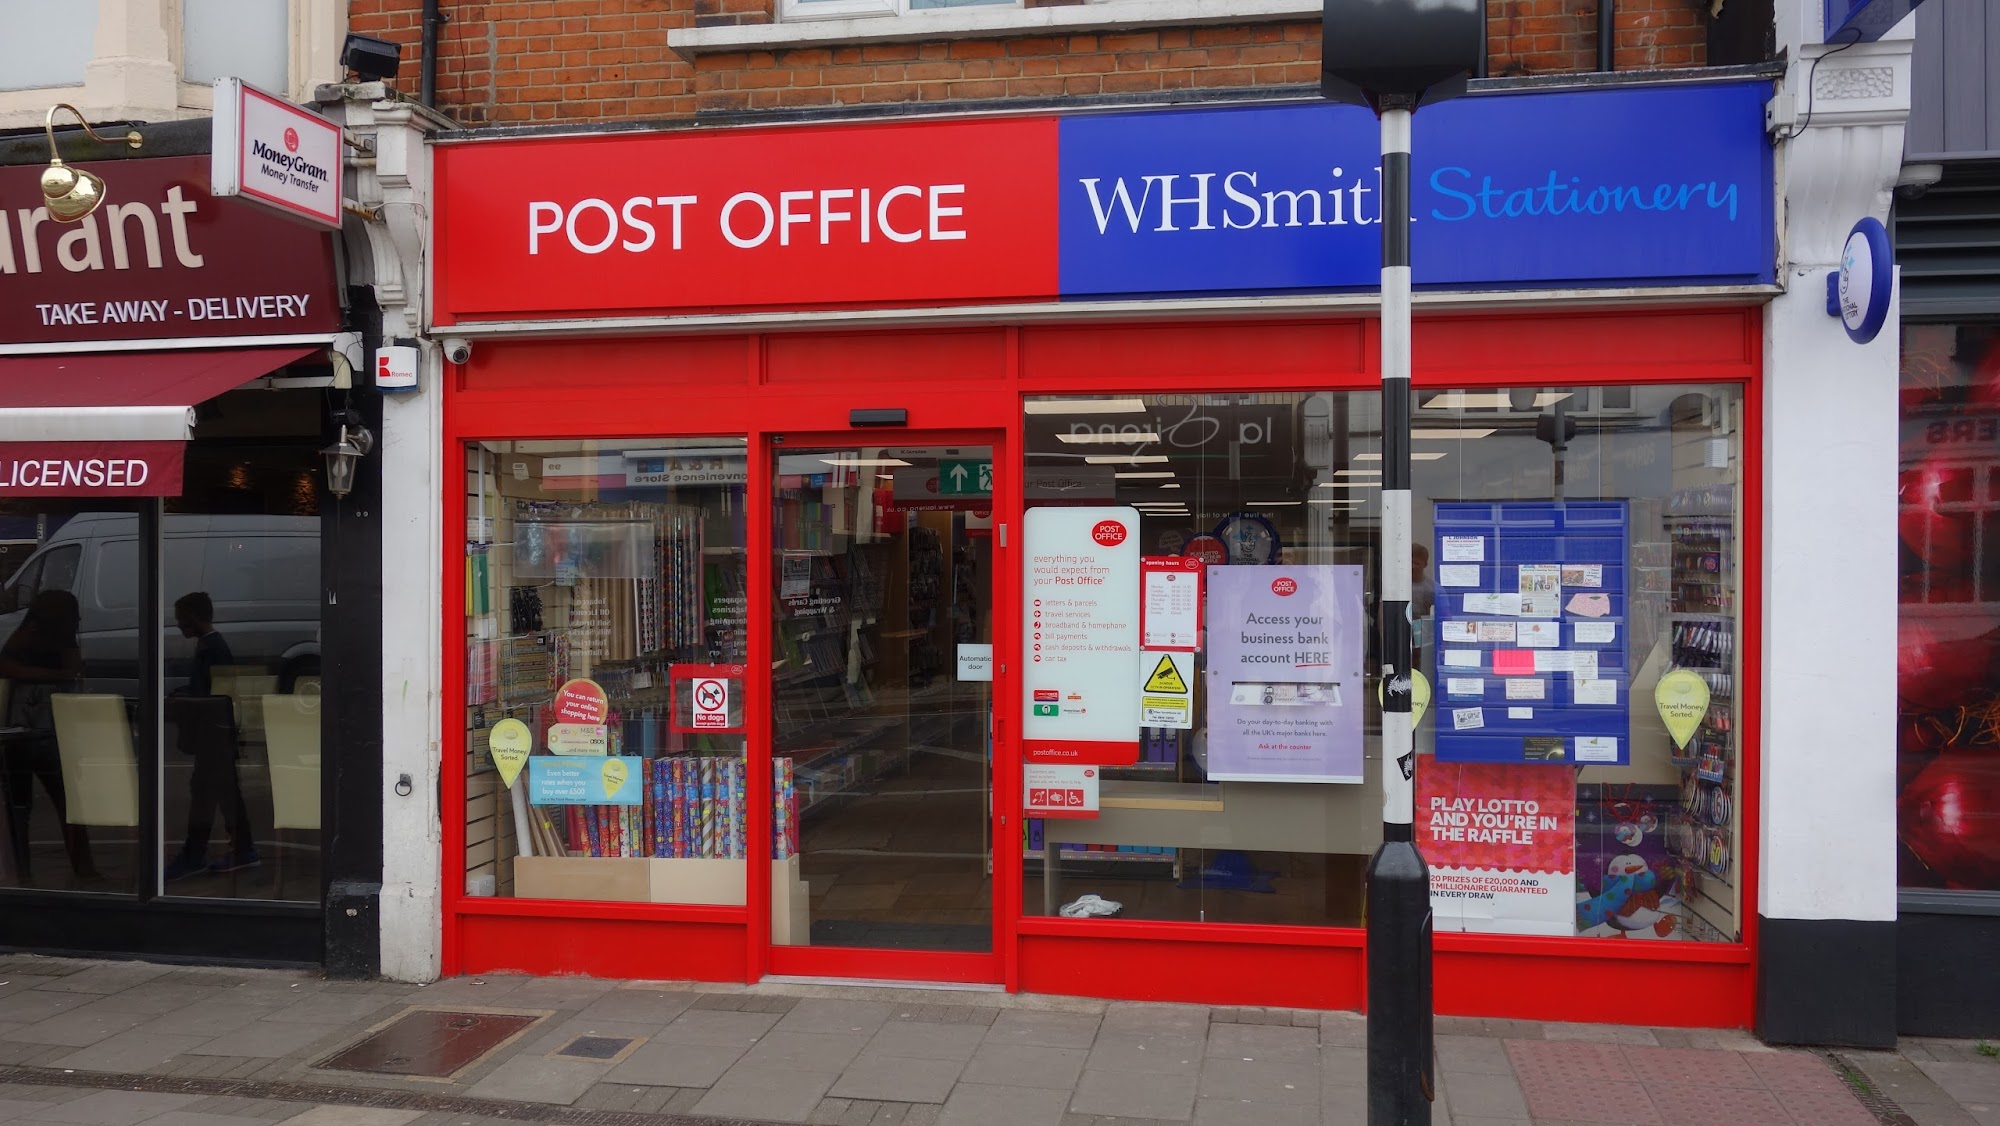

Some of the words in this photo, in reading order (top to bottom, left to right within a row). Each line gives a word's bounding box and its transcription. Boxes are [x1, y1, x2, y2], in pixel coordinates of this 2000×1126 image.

[253, 140, 326, 181] MoneyGram
[261, 164, 288, 184] Money
[290, 174, 319, 193] Transfer
[1079, 167, 1416, 235] WHSmit
[1429, 166, 1738, 221] Stationery
[529, 196, 697, 255] POST
[720, 184, 967, 248] OFFICE
[36, 302, 98, 326] TAKE
[102, 300, 169, 323] AWAY
[188, 294, 310, 321] DELIVERY
[1034, 555, 1077, 564] everything
[1080, 556, 1094, 564] you
[1061, 566, 1087, 575] expect
[1034, 578, 1052, 586] your
[1074, 600, 1097, 608] parcels
[1246, 613, 1290, 625] Access
[1294, 616, 1323, 628] your
[1241, 632, 1293, 644] business
[1298, 632, 1328, 644] bank
[1061, 644, 1087, 652] deposits
[1241, 653, 1290, 663] account
[564, 690, 574, 698] You
[587, 695, 604, 704] return
[565, 701, 579, 709] your
[581, 701, 598, 712] online
[1681, 703, 1705, 711] Money.
[561, 709, 586, 721] shopping
[708, 714, 724, 722] dogs
[1033, 749, 1078, 757] postoffice.co.uk
[543, 788, 553, 796] buy
[1430, 797, 1475, 812] PLAY
[1478, 798, 1539, 814] LOTTO
[1430, 812, 1469, 826] AND
[1471, 813, 1538, 830] YOU'RE
[1540, 816, 1557, 831] IN
[1430, 827, 1464, 841] THE
[1467, 829, 1533, 845] RAFFLE
[1484, 877, 1519, 885] £20,000
[1436, 883, 1489, 892] MILLIONAIRE
[1490, 886, 1548, 895] GUARANTEED
